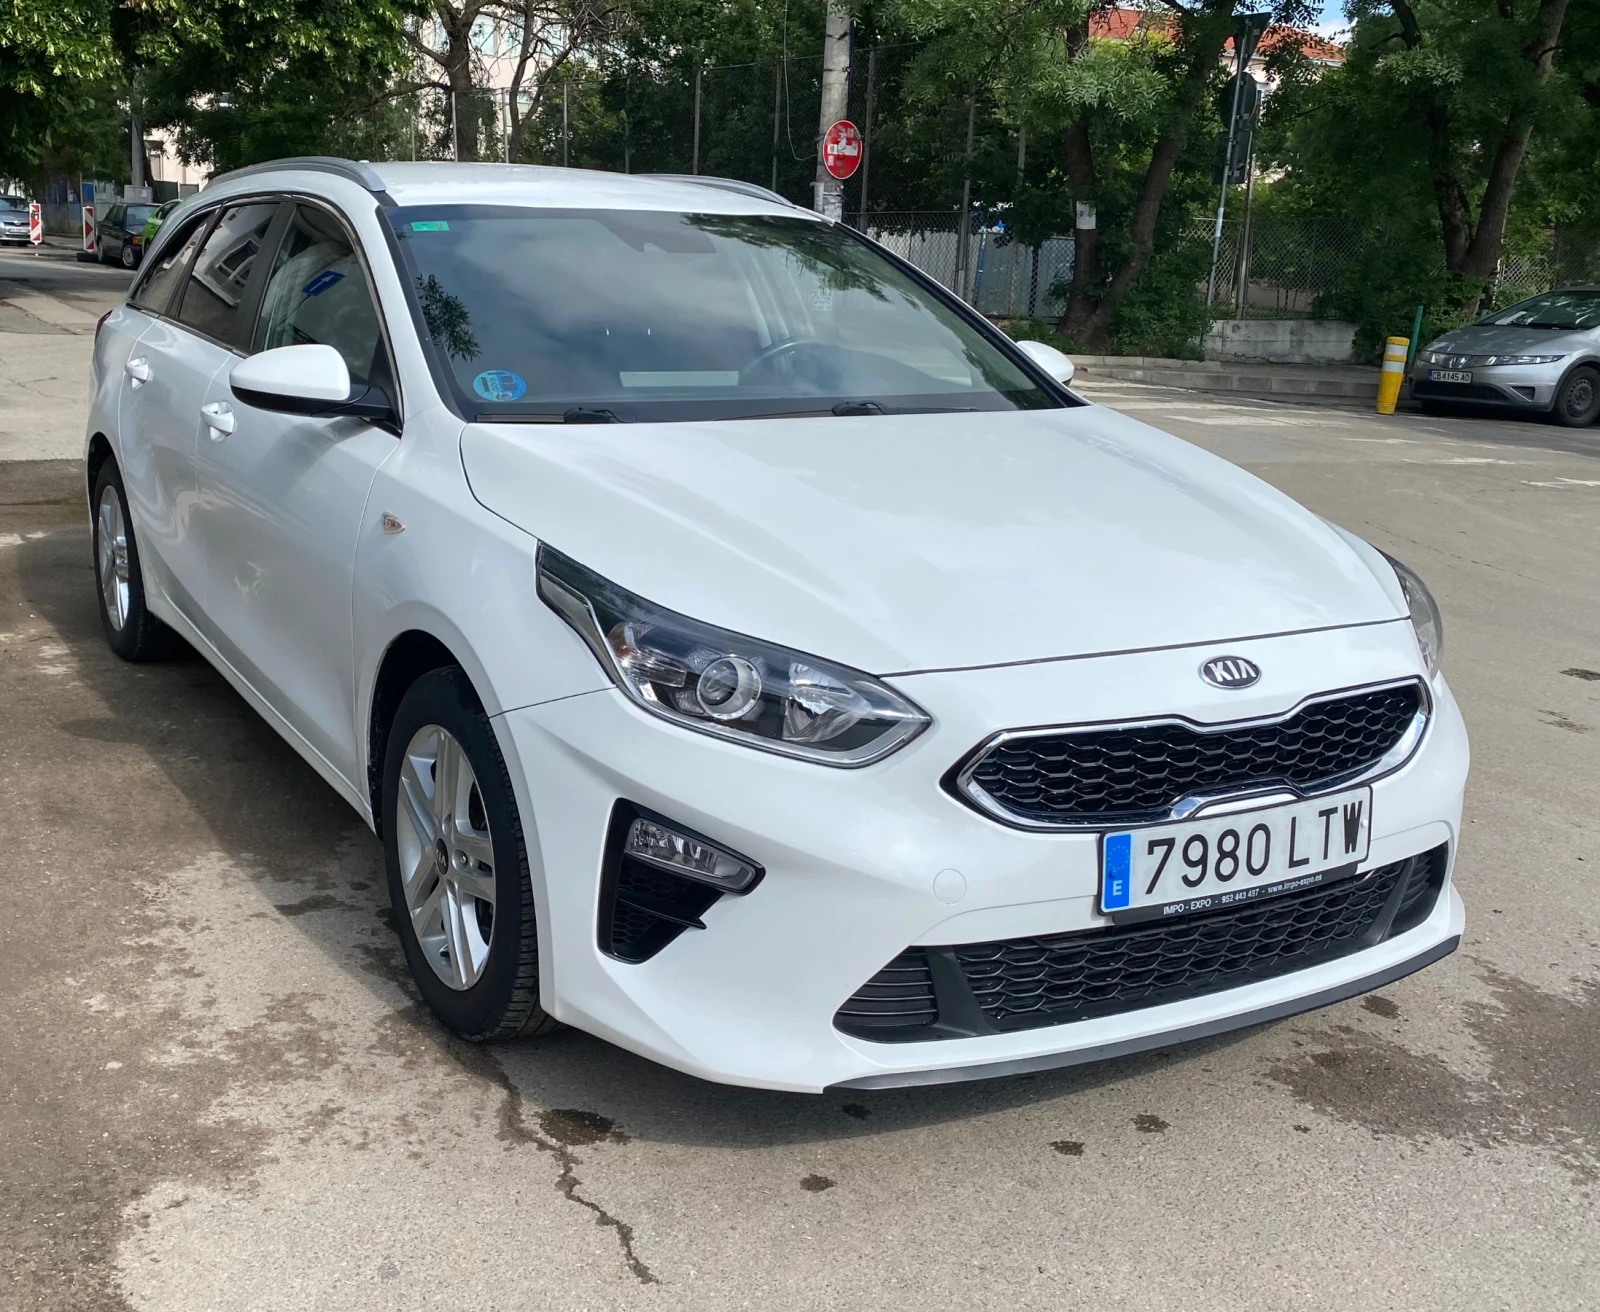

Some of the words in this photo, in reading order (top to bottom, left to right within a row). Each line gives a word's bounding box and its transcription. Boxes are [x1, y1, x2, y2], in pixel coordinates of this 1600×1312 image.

[1442, 372, 1459, 381] 4145
[1207, 659, 1257, 682] KIA
[1145, 823, 1271, 895] 7980
[1288, 800, 1363, 869] LTW
[1112, 879, 1123, 896] E
[1163, 903, 1184, 915] IMPO
[1190, 898, 1211, 911] EXPO
[1221, 893, 1234, 904] 952
[1234, 891, 1247, 901] 443
[1247, 889, 1260, 898] 497
[1267, 874, 1323, 894] www.impo-expo.es
